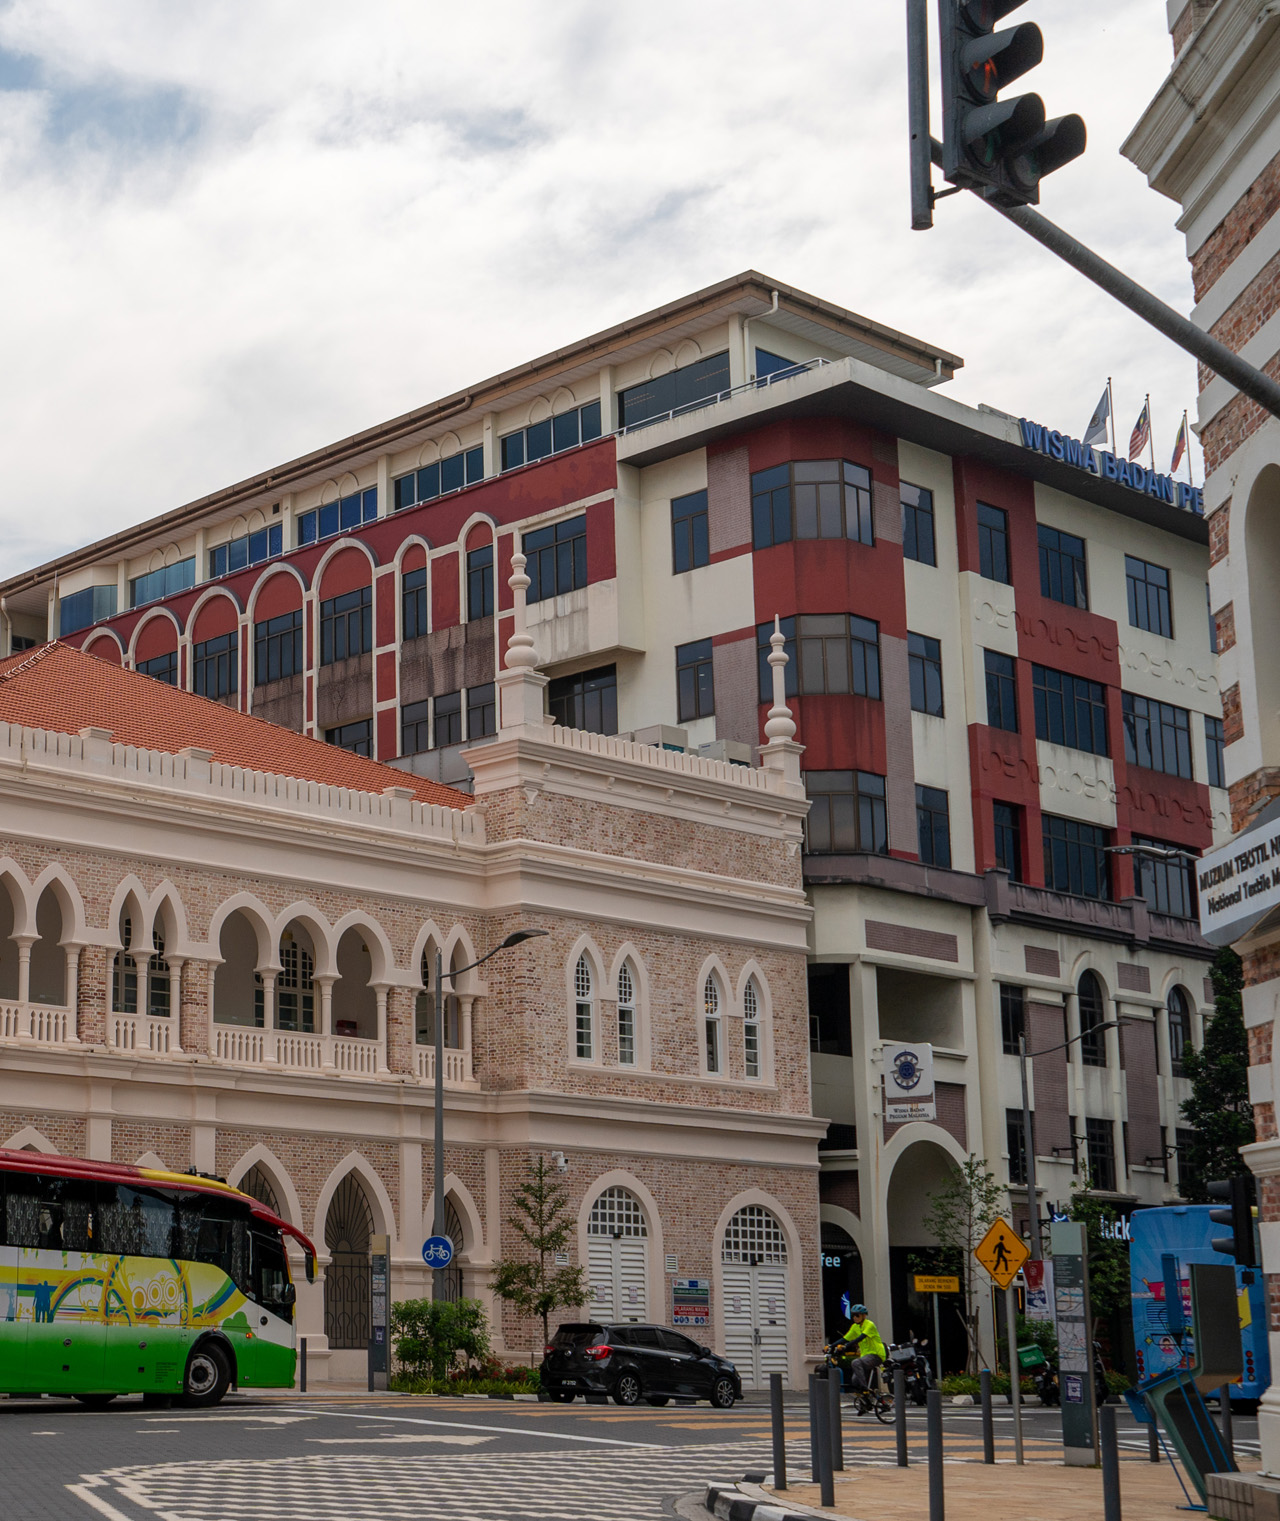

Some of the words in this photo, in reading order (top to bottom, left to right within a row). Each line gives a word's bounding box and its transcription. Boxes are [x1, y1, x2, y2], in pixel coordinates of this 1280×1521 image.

[1019, 417, 1098, 473] WISMA
[1101, 450, 1174, 503] BADAN
[1199, 859, 1233, 892] MUZIUM
[1234, 842, 1270, 874] TEKSTIL
[1207, 885, 1242, 915] National
[1243, 874, 1271, 899] Textile
[821, 1253, 841, 1267] fee
